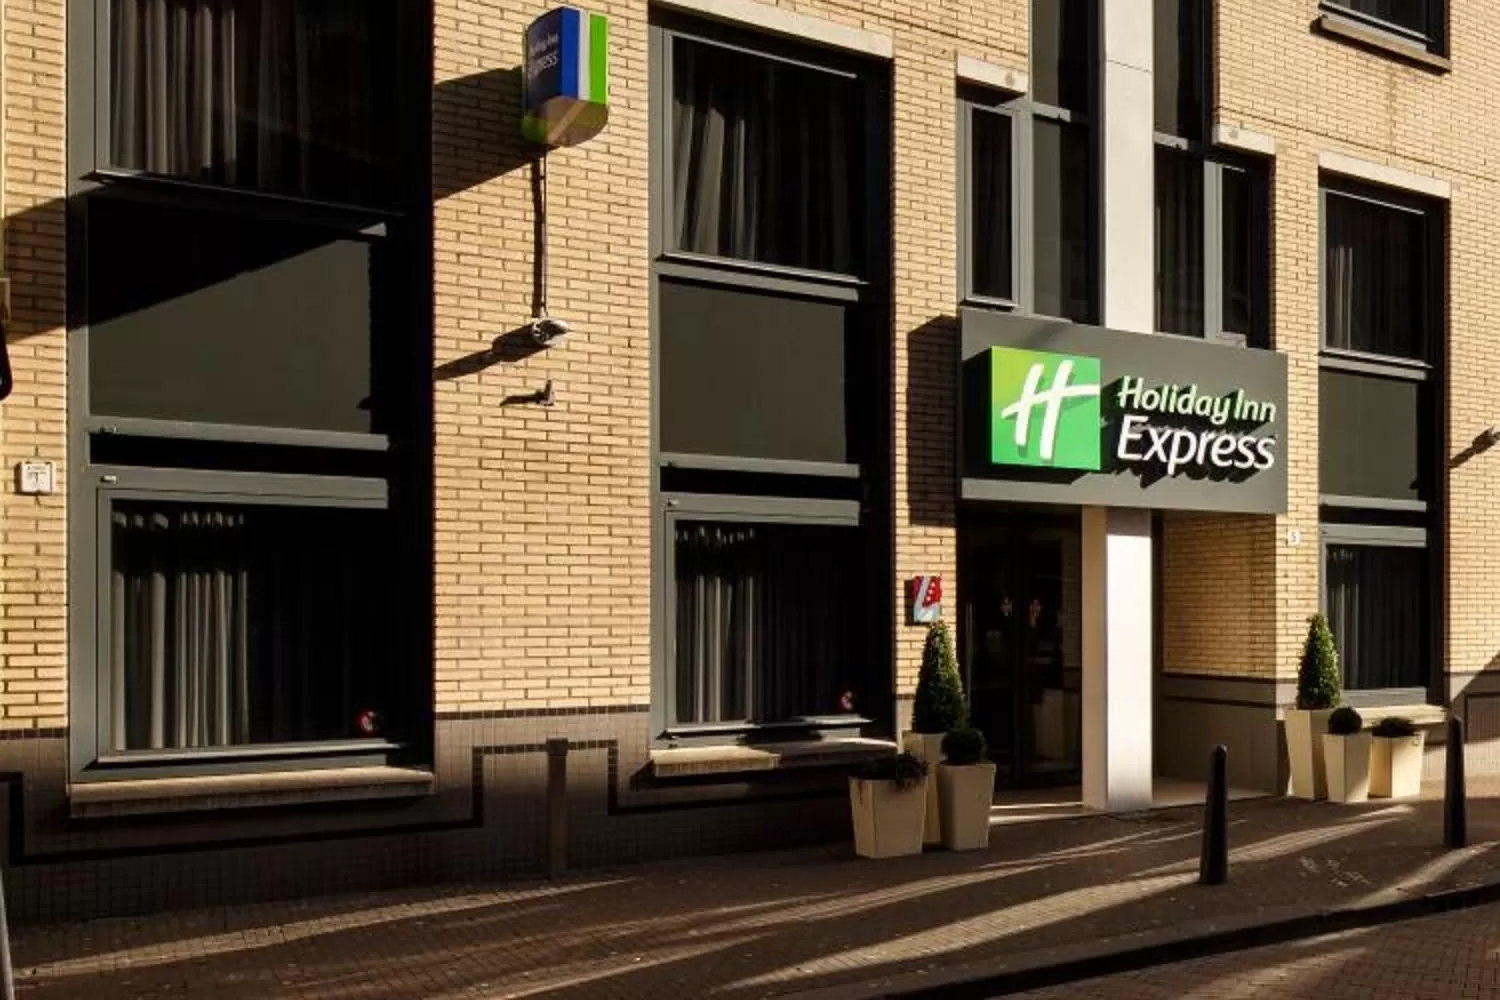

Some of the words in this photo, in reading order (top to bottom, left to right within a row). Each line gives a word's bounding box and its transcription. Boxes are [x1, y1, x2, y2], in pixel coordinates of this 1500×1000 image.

[1117, 375, 1230, 425] Holiday
[1233, 388, 1277, 422] Inn
[1117, 414, 1277, 475] Express
